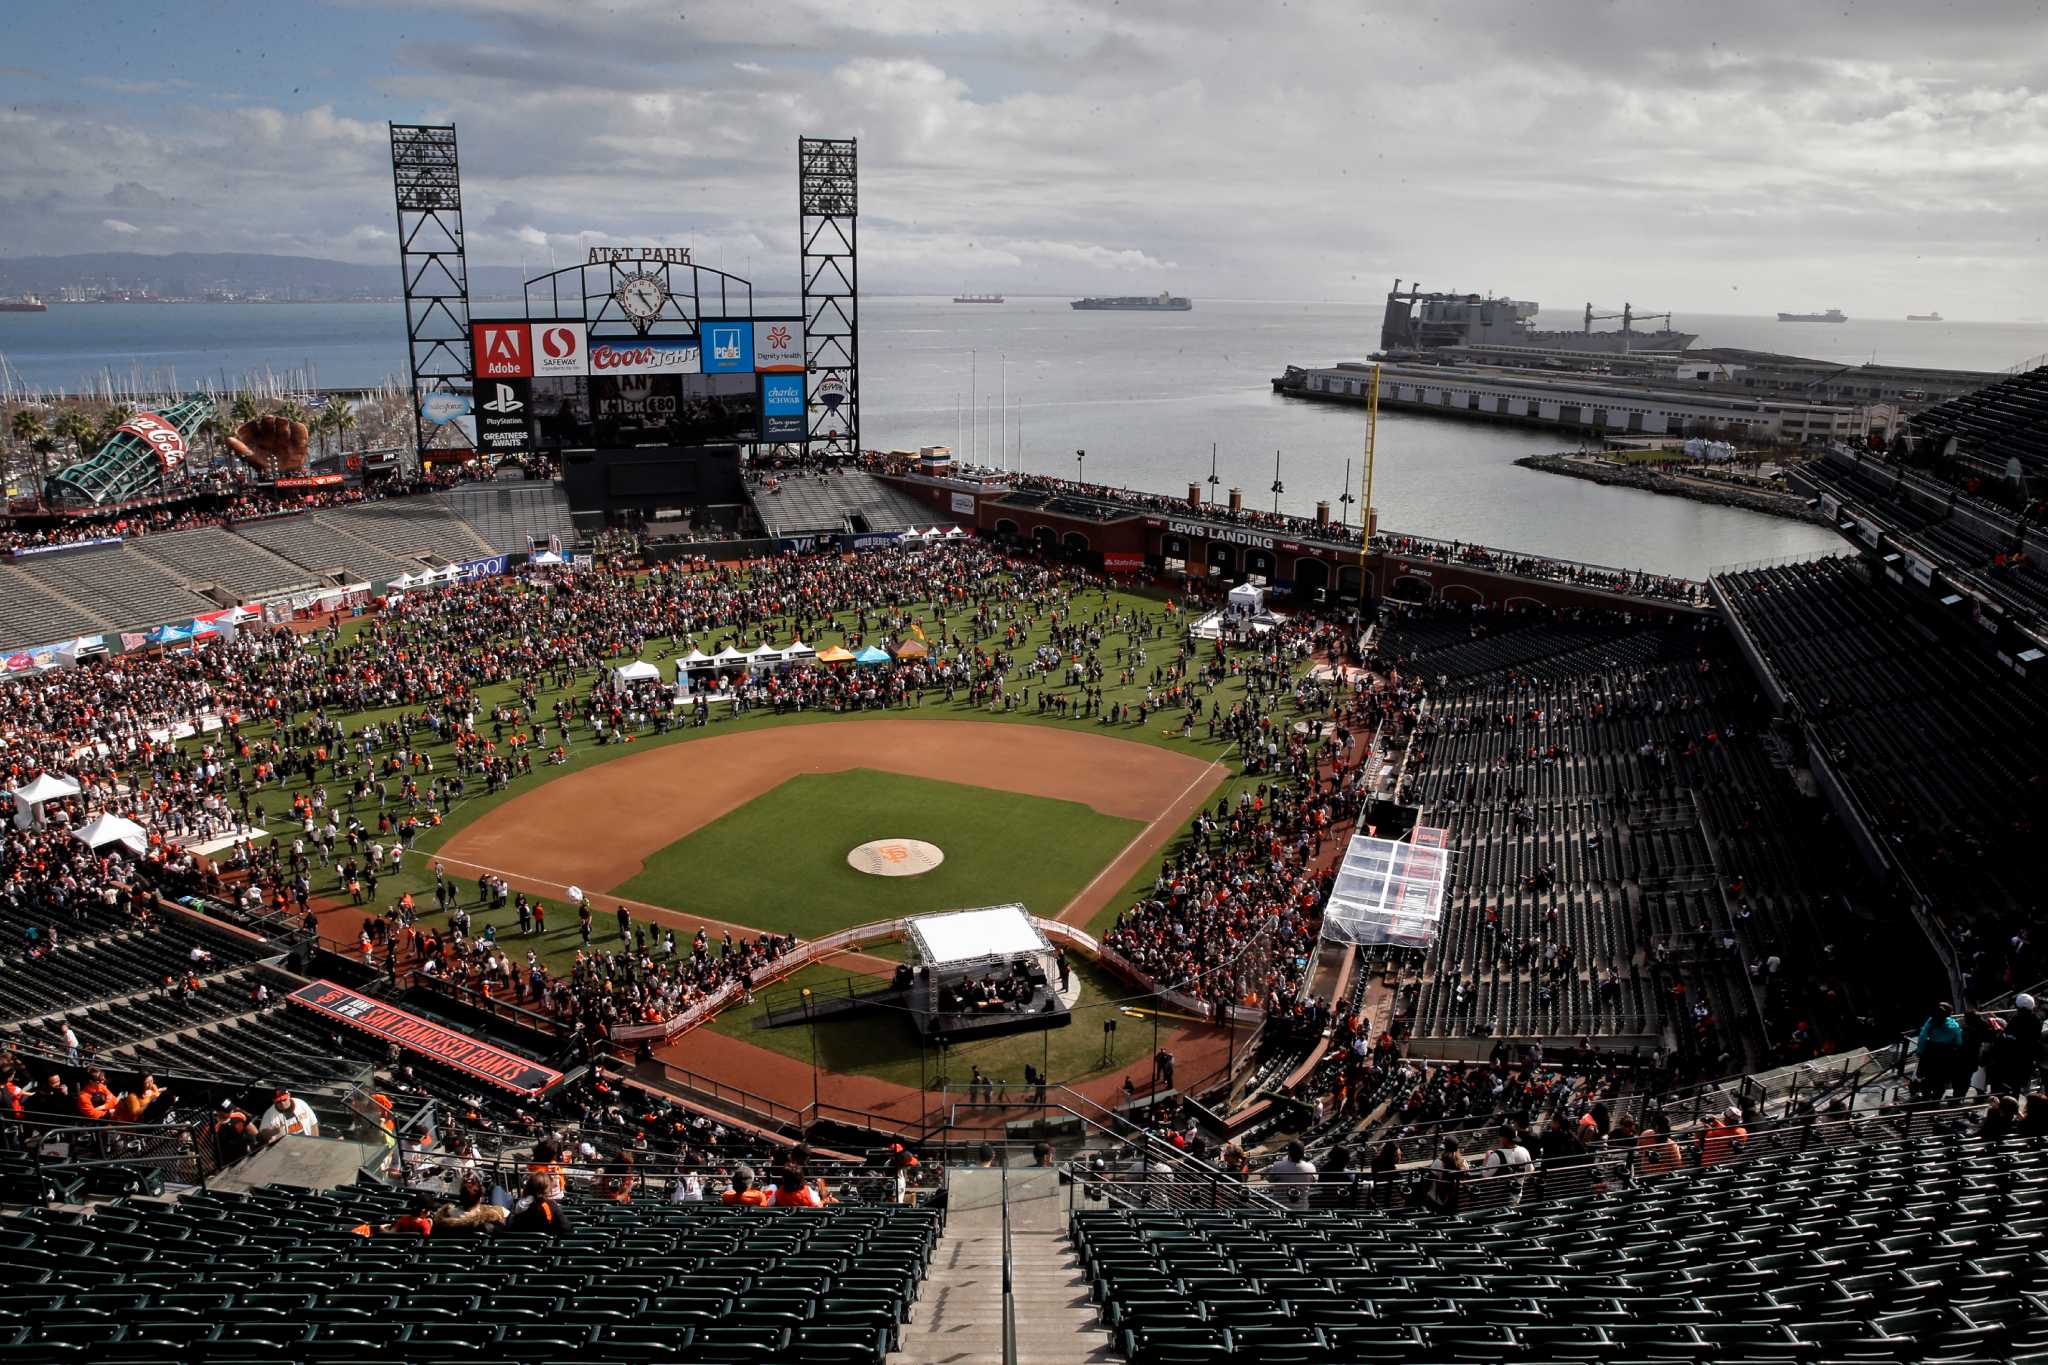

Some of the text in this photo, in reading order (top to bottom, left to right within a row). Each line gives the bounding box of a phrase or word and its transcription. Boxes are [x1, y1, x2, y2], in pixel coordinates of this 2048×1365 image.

[589, 248, 691, 264] AT&T PARK
[592, 344, 698, 369] Coors LIGHT
[716, 346, 740, 358] PG&E
[757, 352, 780, 360] Dignity
[488, 362, 520, 374] Adobe
[768, 386, 798, 396] charles
[483, 432, 528, 440] GREATNESS
[1208, 526, 1274, 550] LANDING
[462, 558, 502, 577] HOO!
[359, 1008, 530, 1080] SAN FRANCISCO GIANTS
